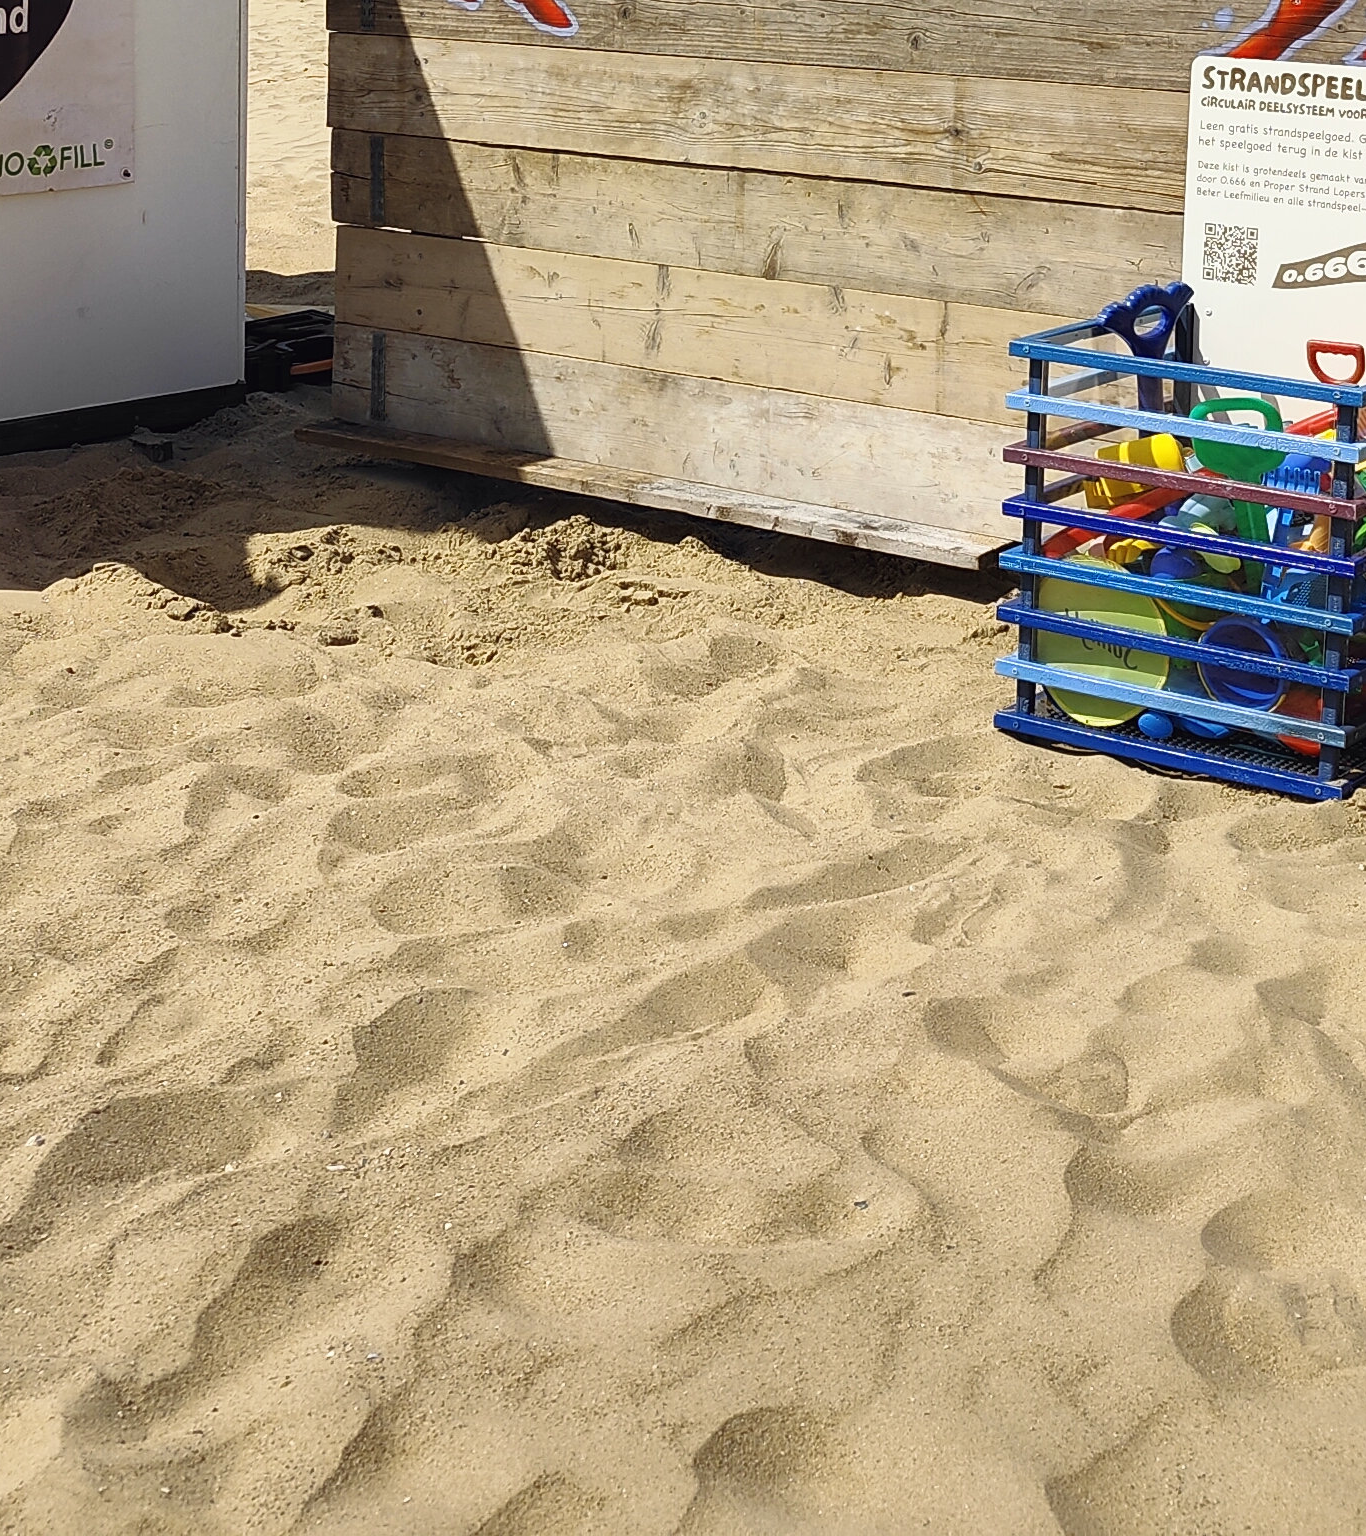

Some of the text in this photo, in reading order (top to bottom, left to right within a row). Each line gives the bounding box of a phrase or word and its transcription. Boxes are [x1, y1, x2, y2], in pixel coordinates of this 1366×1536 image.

[1259, 101, 1335, 117] DEELSYSTEEM
[1200, 120, 1224, 131] Leen
[1228, 124, 1258, 135] gratis
[1263, 126, 1354, 144] strandspeelgoed.
[1198, 136, 1215, 146] het
[1219, 139, 1272, 153] speelgoed
[1278, 143, 1306, 158] terug
[1311, 146, 1320, 156] in
[1324, 148, 1338, 158] de
[1342, 149, 1362, 160] kist
[1197, 160, 1219, 170] Deze
[1222, 163, 1239, 172] kist
[1242, 164, 1249, 173] is
[1253, 167, 1306, 178] grotendeels
[1310, 173, 1350, 183] gemaakt
[1196, 174, 1217, 183] door
[1220, 176, 1246, 186] 0.666
[1249, 180, 1260, 188] en
[1263, 180, 1295, 192] Proper
[1298, 184, 1329, 195] Strand
[1334, 188, 1365, 199] Lopers
[1196, 187, 1221, 197] Beter
[1224, 190, 1269, 203] Leefmilieu
[1273, 196, 1284, 204] en
[1287, 196, 1304, 206] alle
